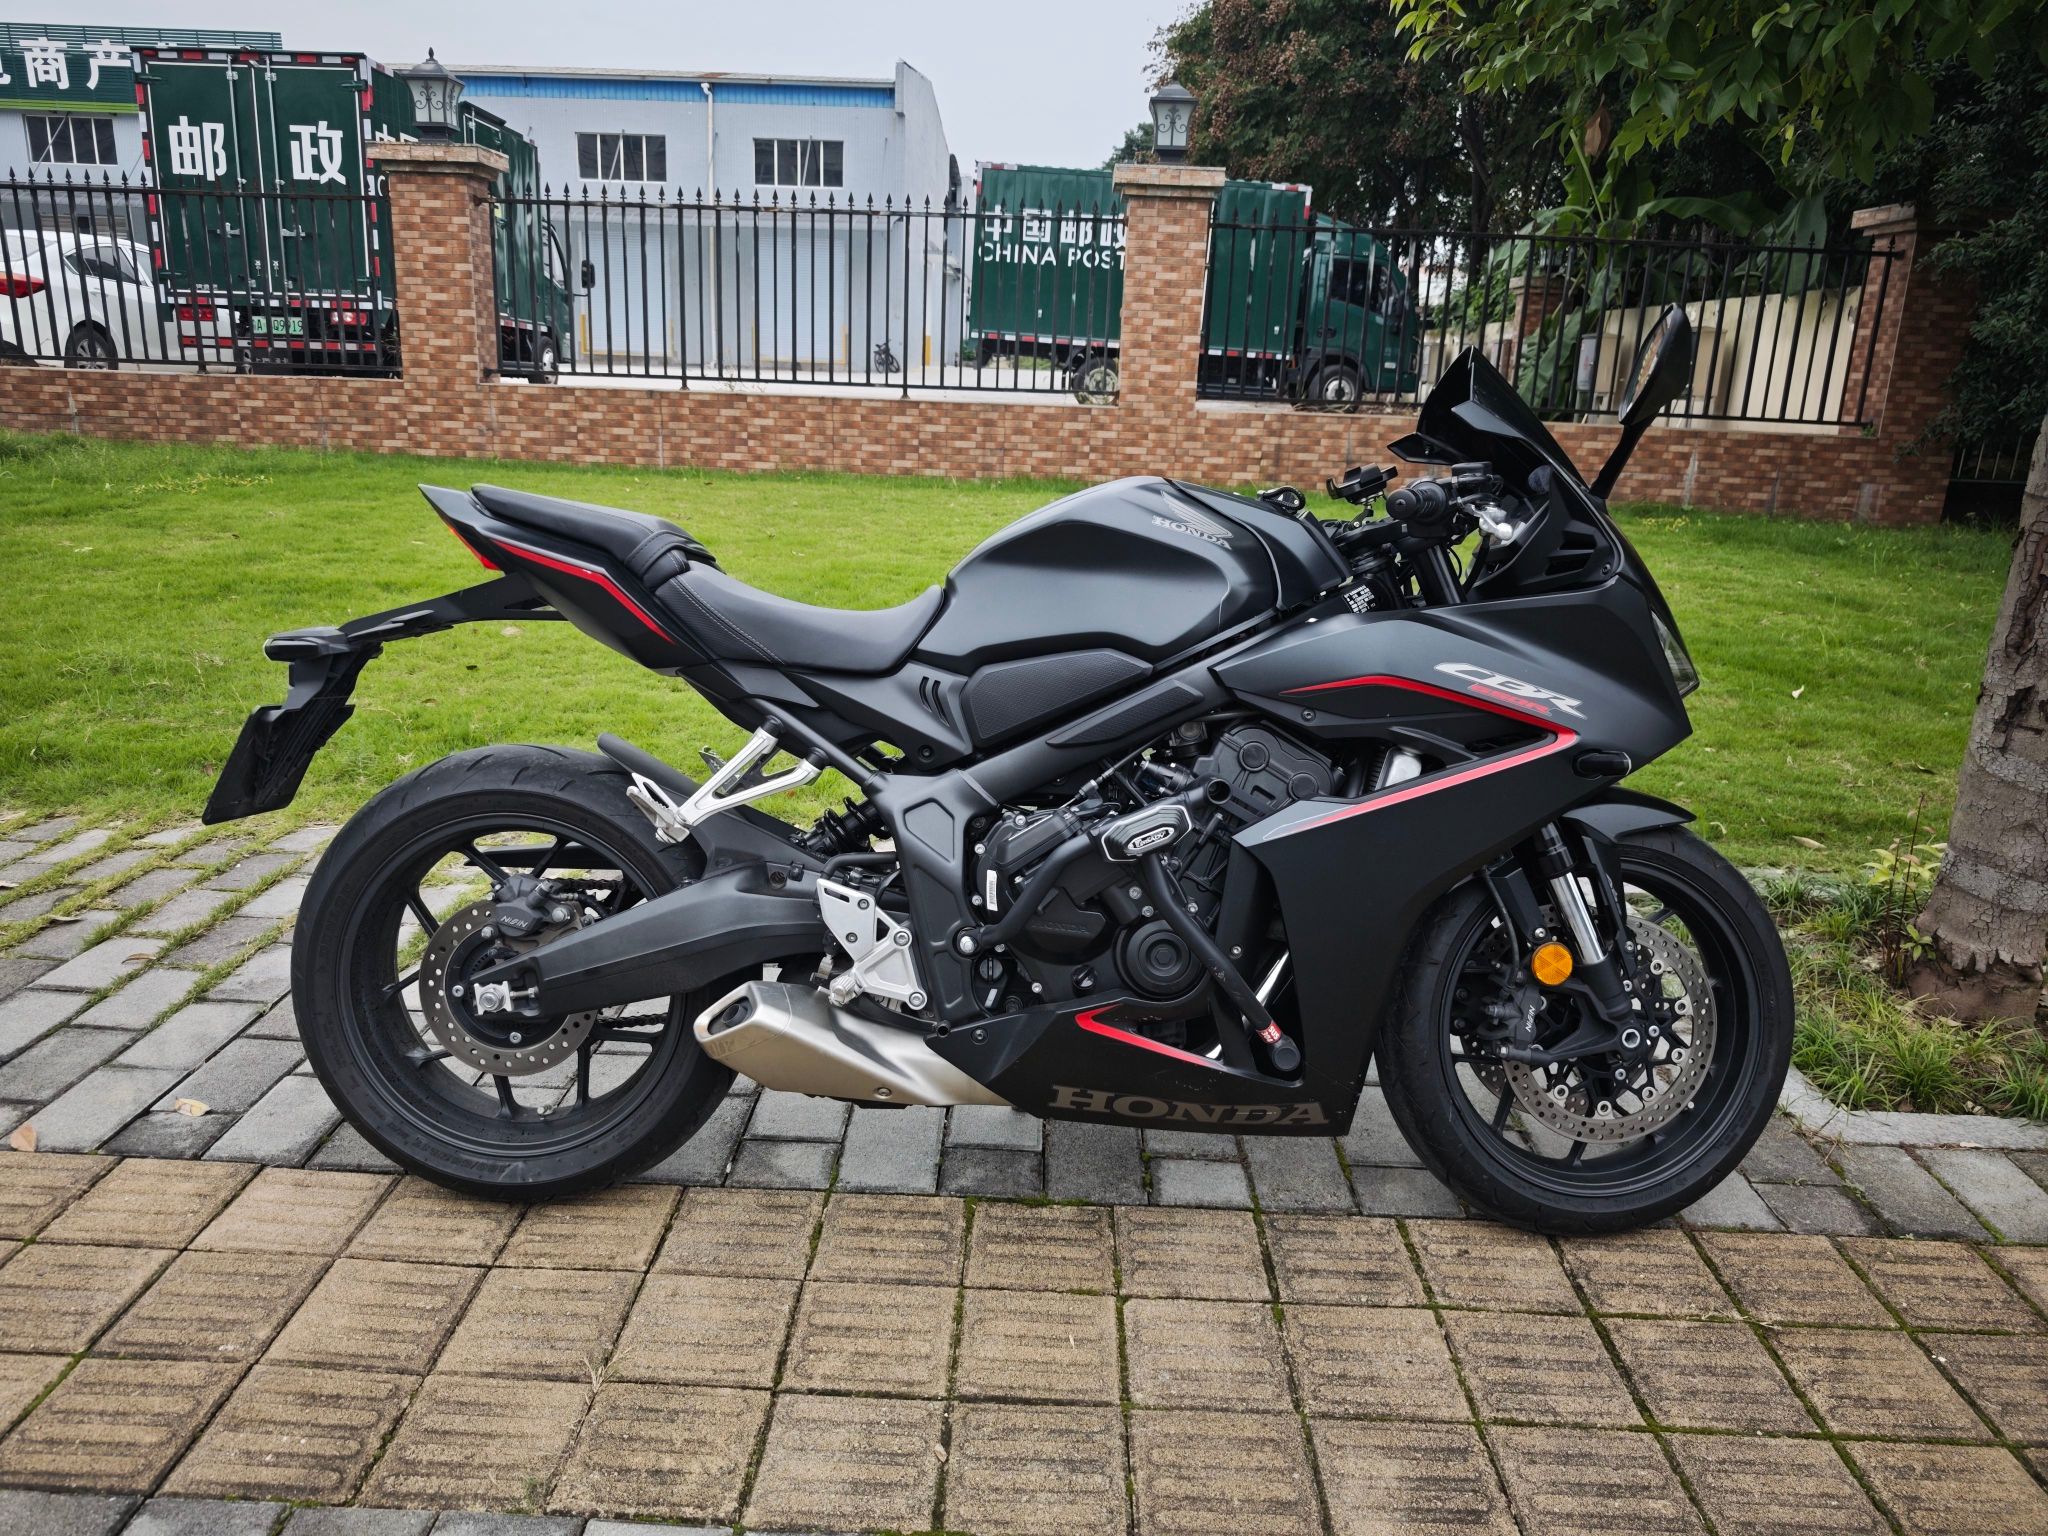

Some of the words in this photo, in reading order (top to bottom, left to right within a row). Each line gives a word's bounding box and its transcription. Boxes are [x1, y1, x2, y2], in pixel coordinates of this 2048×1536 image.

[0, 37, 178, 90] 商产
[168, 116, 346, 185] 邮政
[978, 242, 1057, 266] CHINA
[1067, 247, 1126, 270] POST
[1152, 515, 1232, 550] HONDA
[1434, 662, 1587, 720] CBR
[1049, 1085, 1329, 1125] HONDA
